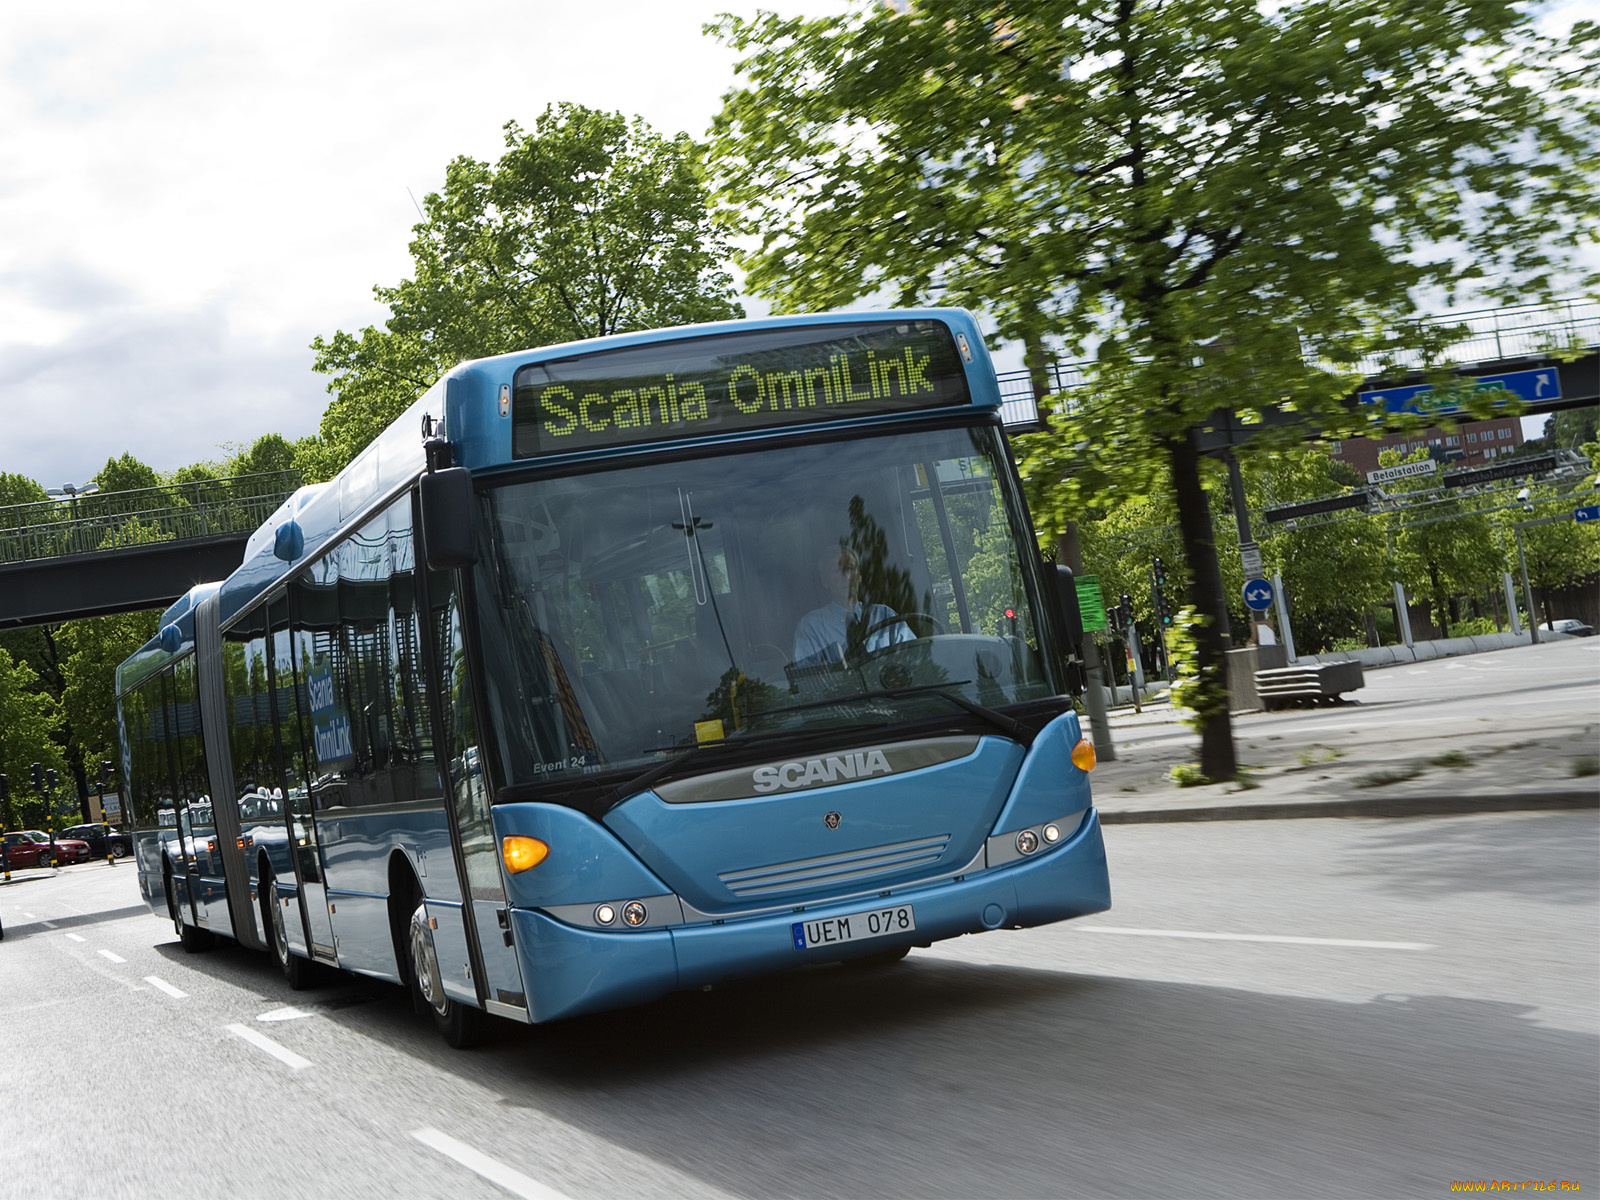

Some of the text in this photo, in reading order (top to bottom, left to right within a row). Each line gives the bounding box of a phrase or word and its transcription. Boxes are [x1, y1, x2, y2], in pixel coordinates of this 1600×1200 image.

[540, 346, 935, 436] Scania OmniLink
[1372, 463, 1431, 481] Betalstation
[308, 667, 335, 713] Scania
[314, 716, 353, 762] OmniLink
[533, 755, 586, 774] Event 24
[753, 750, 893, 793] SCANIA
[806, 908, 910, 944] UEM 078
